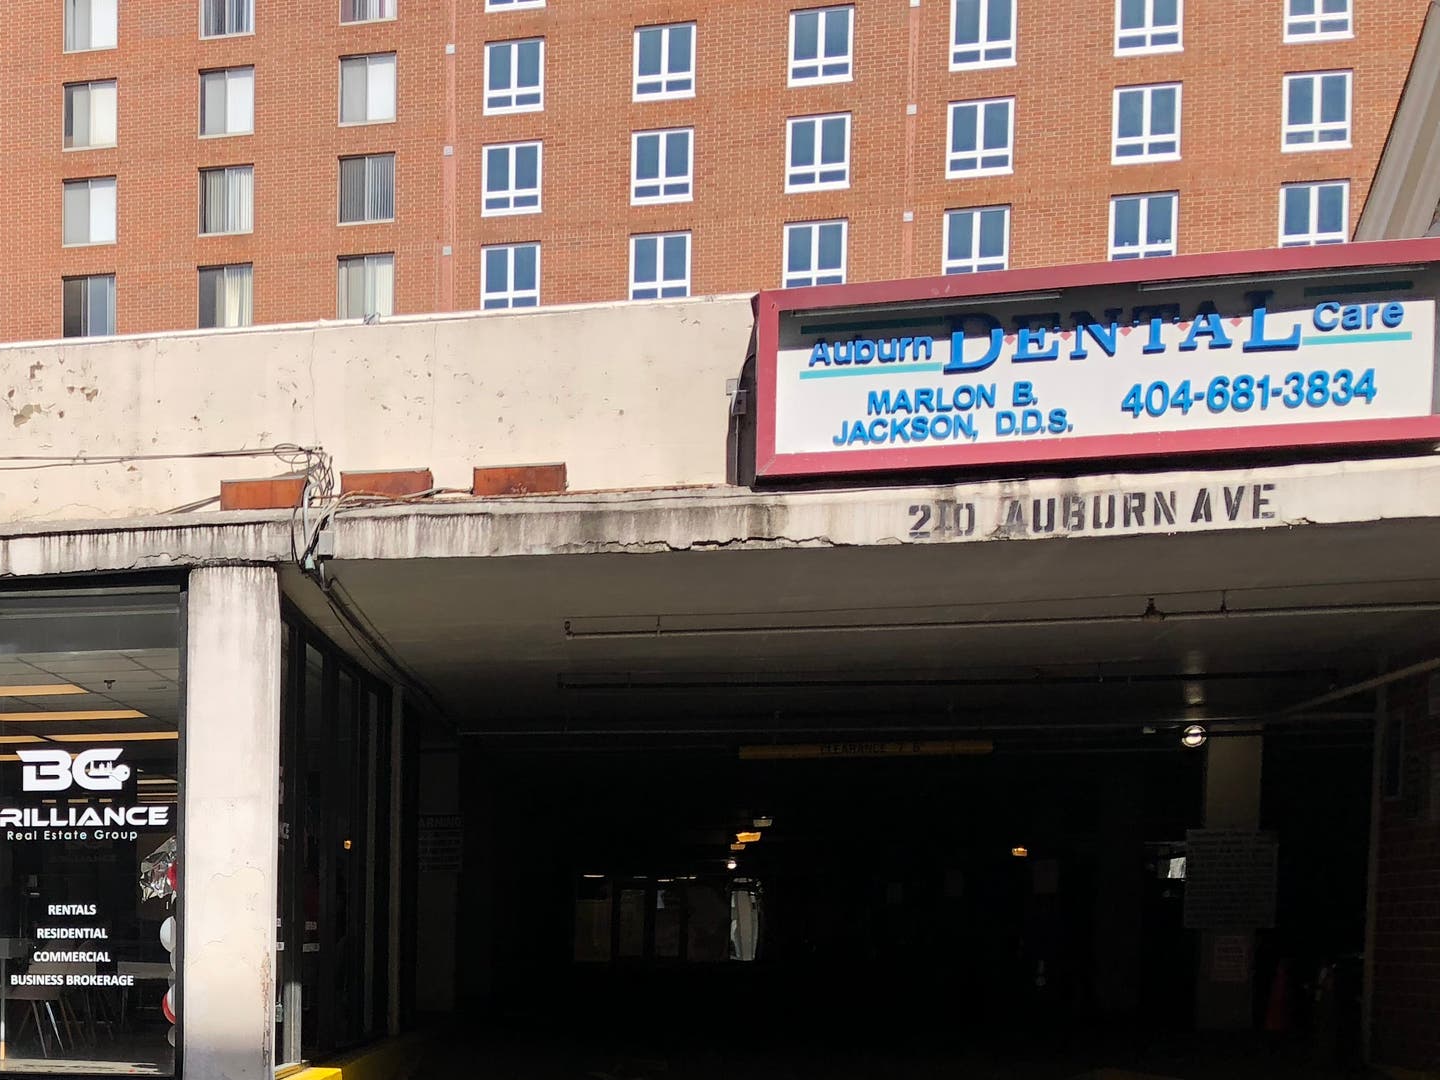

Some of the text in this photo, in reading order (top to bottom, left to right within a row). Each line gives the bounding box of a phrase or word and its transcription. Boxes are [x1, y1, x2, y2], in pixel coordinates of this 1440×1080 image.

[808, 289, 1405, 375] Auburn DENTAL Care
[867, 380, 1038, 415] MARLON B.
[1121, 367, 1378, 417] 404-681-3834
[832, 408, 1074, 446] JACKSON, D.D.S.
[998, 490, 1177, 536] AUBURN
[1191, 484, 1276, 524] AVE
[417, 815, 463, 829] ARNING
[7, 830, 138, 841] Real Estate Group
[48, 904, 97, 915] RENTALS
[36, 928, 108, 939] RESIDENTIAL
[33, 951, 111, 962] COMMERCIAL
[10, 974, 134, 986] BUSINESS BROKERAGE
